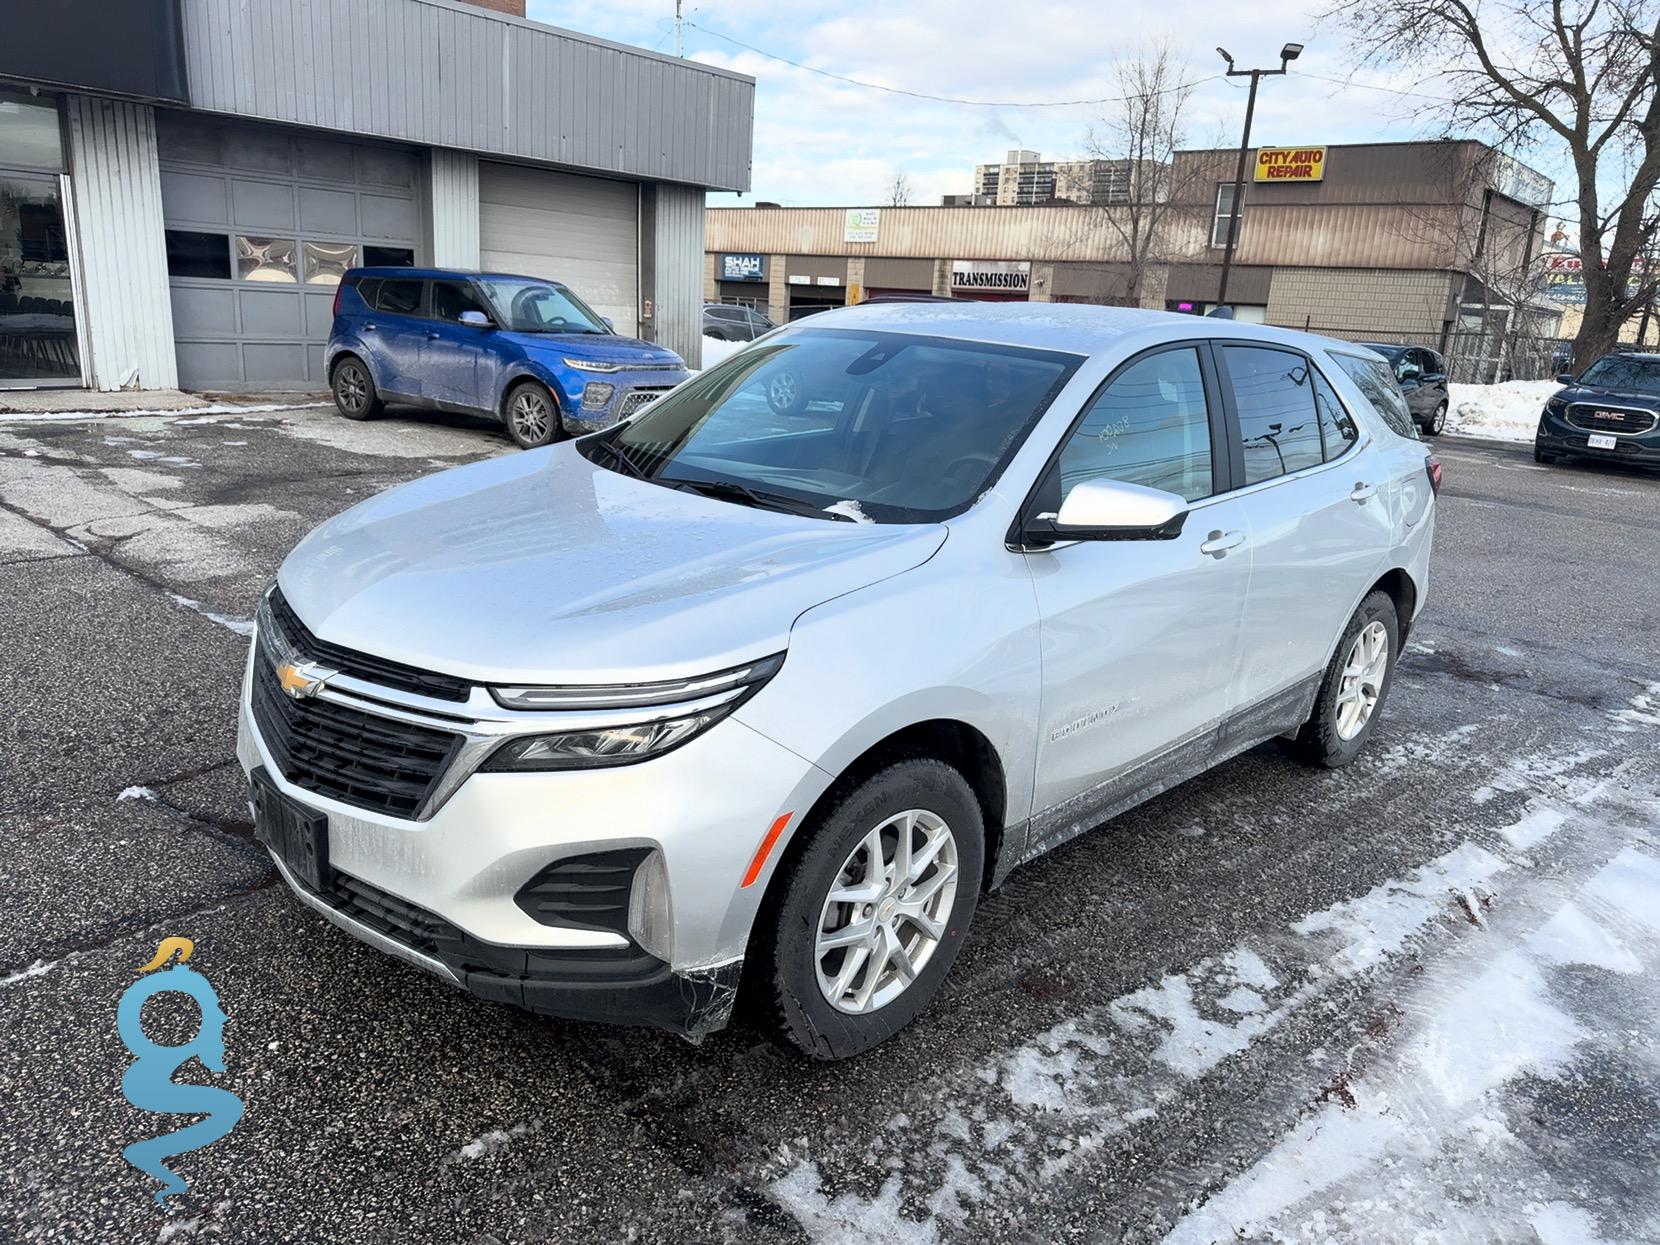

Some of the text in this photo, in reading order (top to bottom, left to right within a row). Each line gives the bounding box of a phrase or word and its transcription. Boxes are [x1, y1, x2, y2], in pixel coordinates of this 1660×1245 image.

[1259, 150, 1323, 165] CITY AUTO
[1267, 165, 1313, 178] REPAIR
[725, 256, 760, 268] SHAH
[952, 272, 1028, 288] TRANSMISSION
[1594, 410, 1625, 421] GMC
[1049, 703, 1120, 743] EQUINOX
